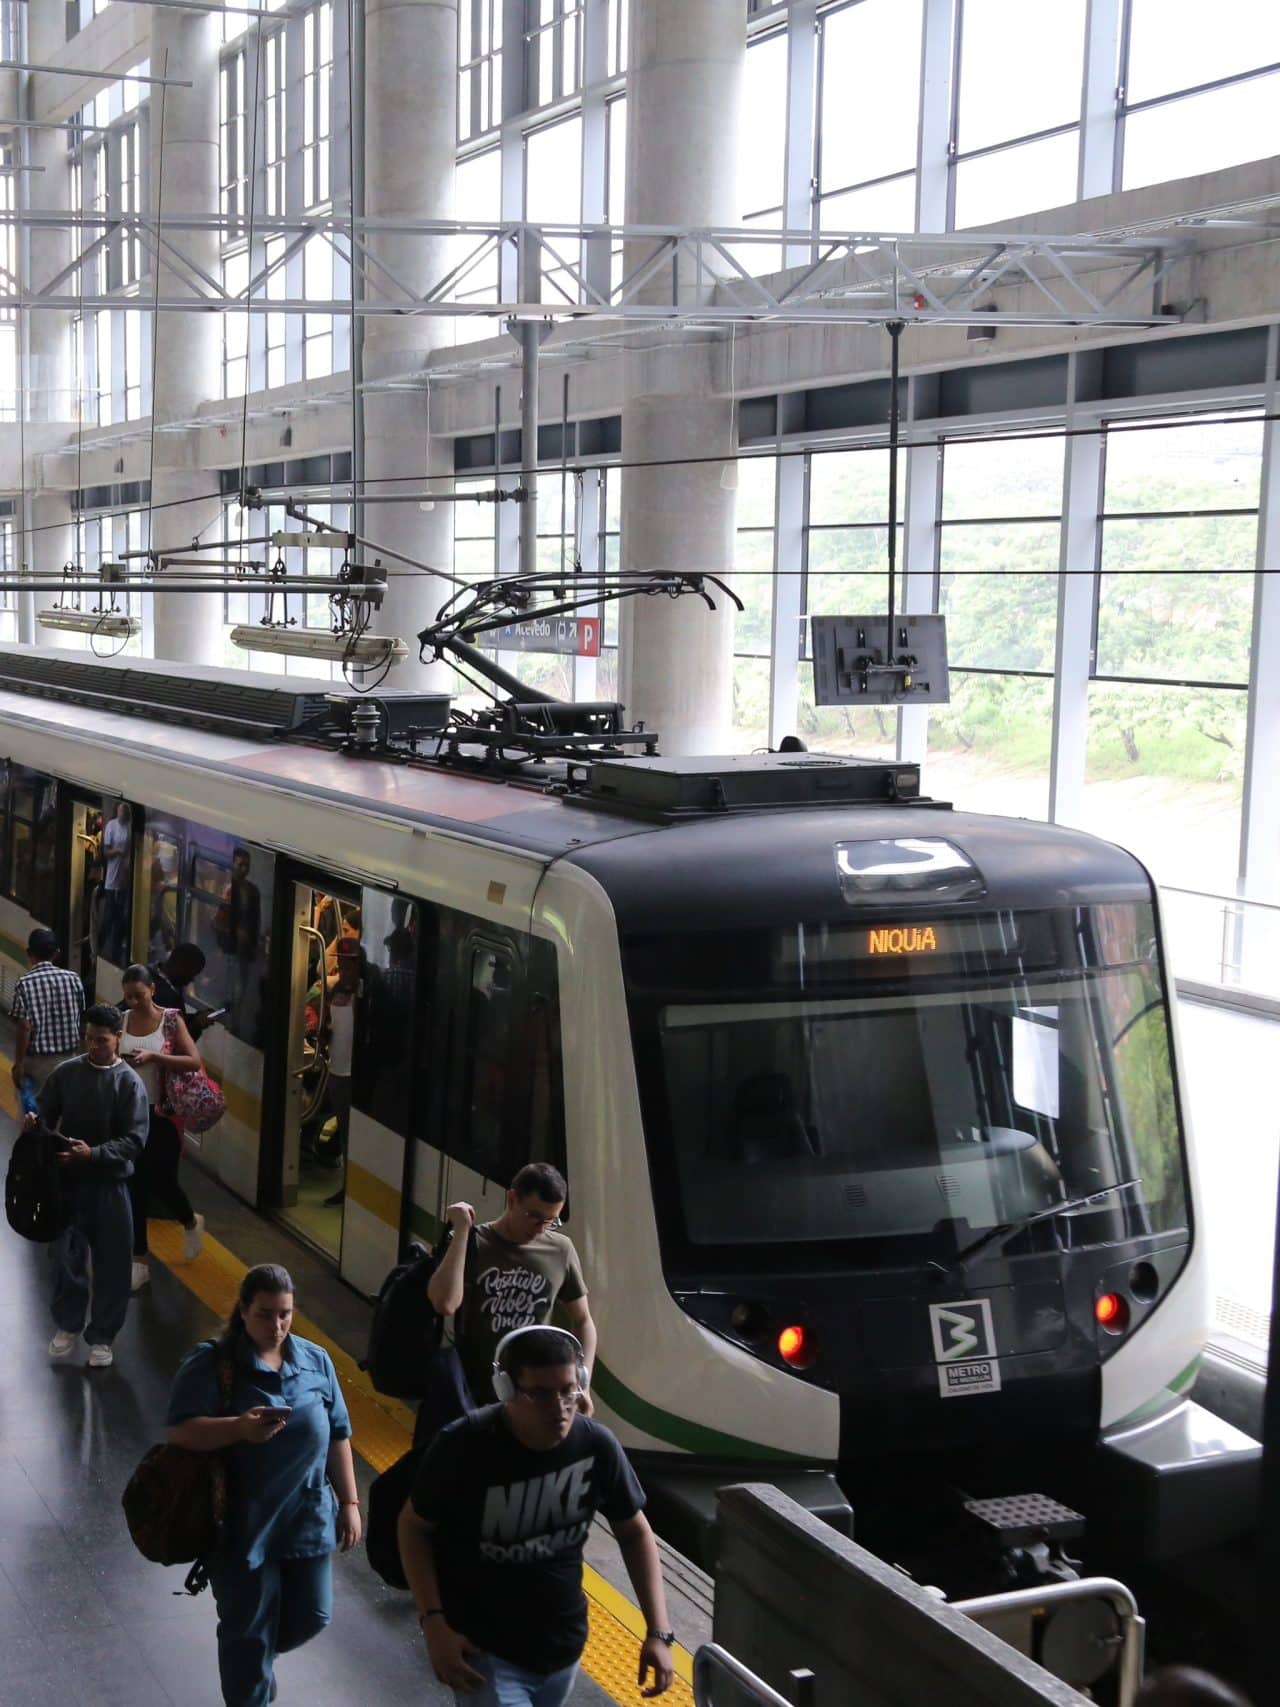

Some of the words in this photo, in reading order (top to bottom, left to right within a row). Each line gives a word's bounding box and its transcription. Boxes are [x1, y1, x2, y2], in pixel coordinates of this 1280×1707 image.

[514, 621, 551, 637] Acevedo
[584, 624, 593, 650] P
[476, 1266, 546, 1295] Positive
[948, 1364, 989, 1378] METRO
[481, 1455, 595, 1546] NIKE
